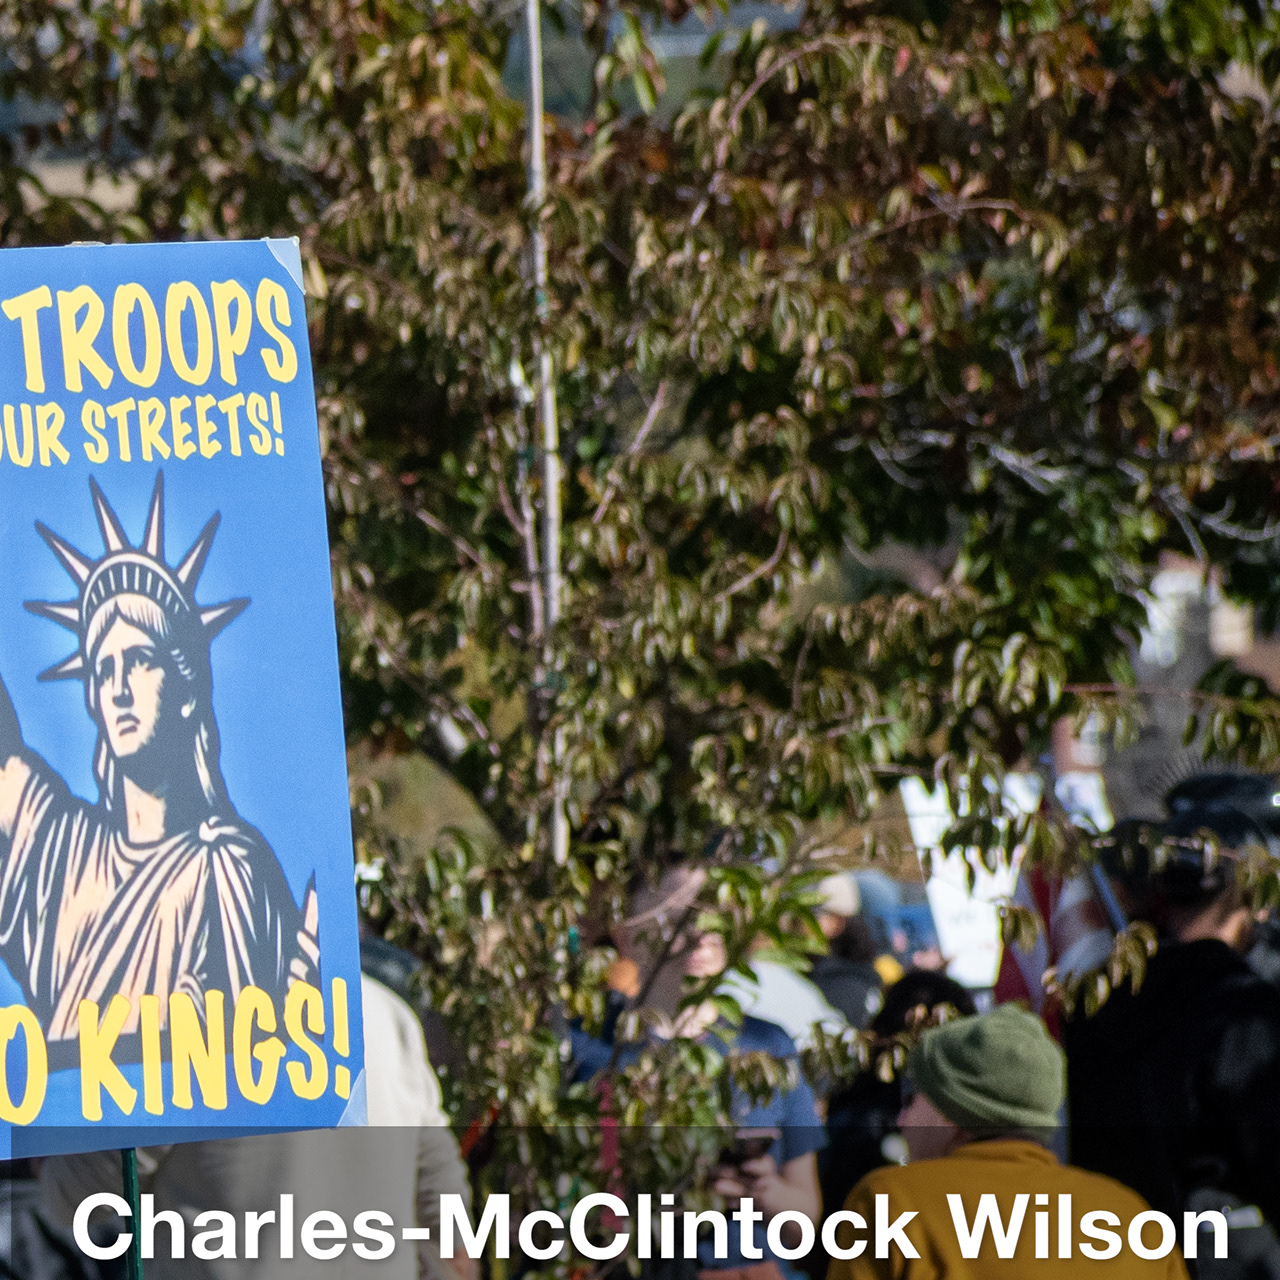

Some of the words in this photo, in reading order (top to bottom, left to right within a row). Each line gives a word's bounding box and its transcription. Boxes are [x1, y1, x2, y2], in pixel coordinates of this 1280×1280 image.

[1, 279, 299, 394] TROOPS
[81, 392, 286, 464] STREETS!
[77, 977, 351, 1123] KINGS!
